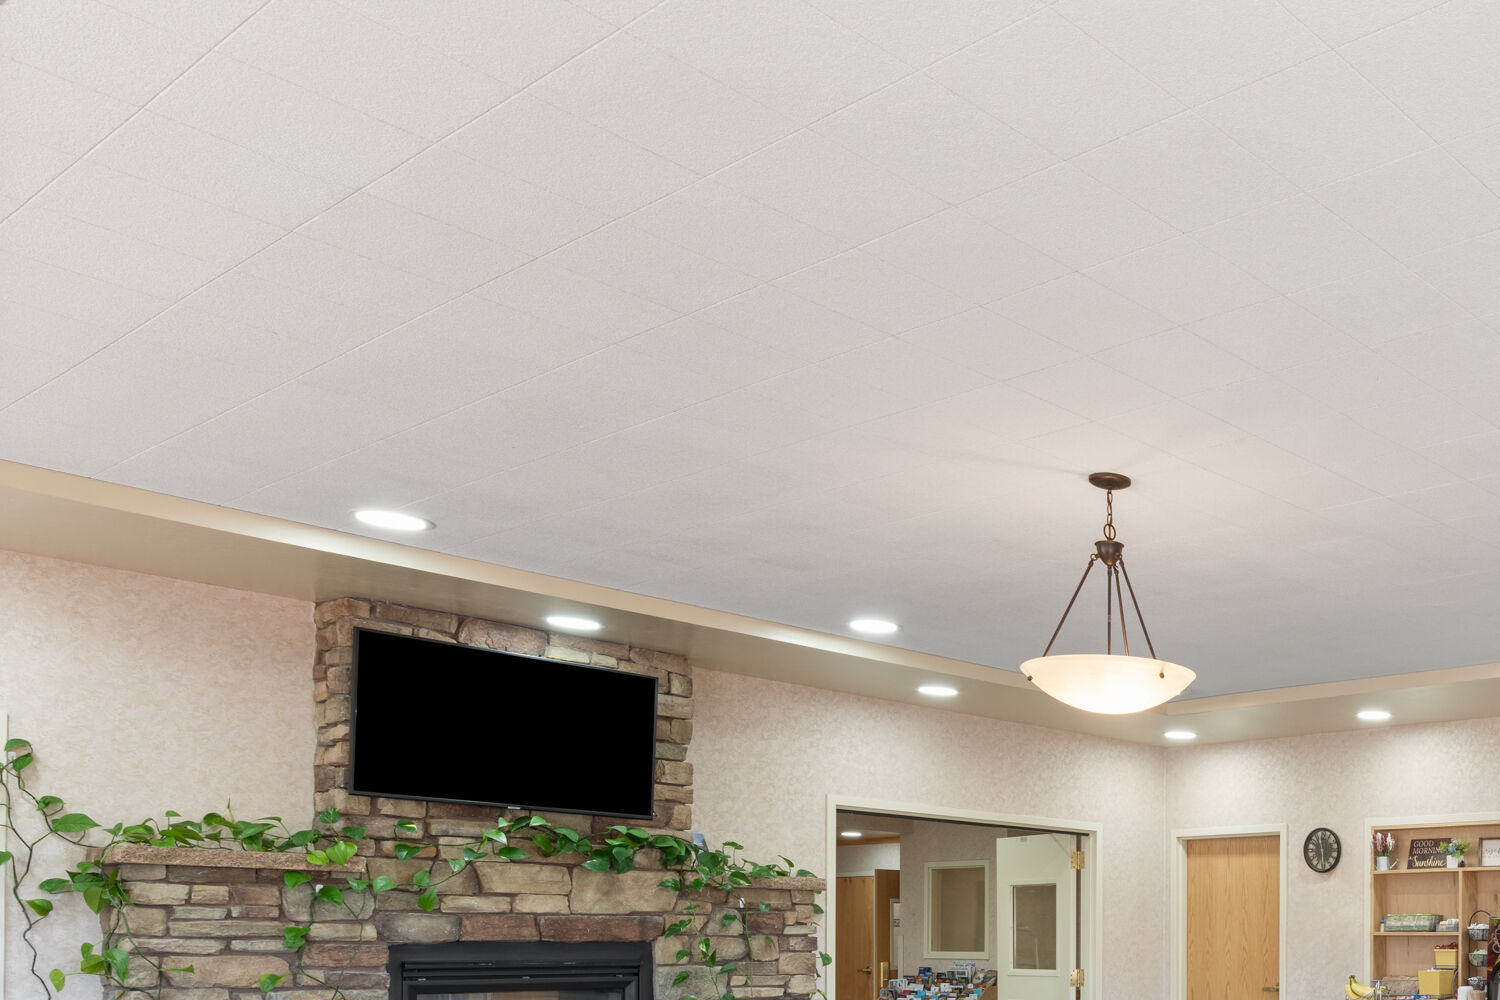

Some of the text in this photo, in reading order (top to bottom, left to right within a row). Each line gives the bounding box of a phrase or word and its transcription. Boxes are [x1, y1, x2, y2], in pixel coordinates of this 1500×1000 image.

[1413, 840, 1435, 848] GOOD
[1412, 846, 1442, 855] MORNIN
[1413, 855, 1446, 867] Sunshine
